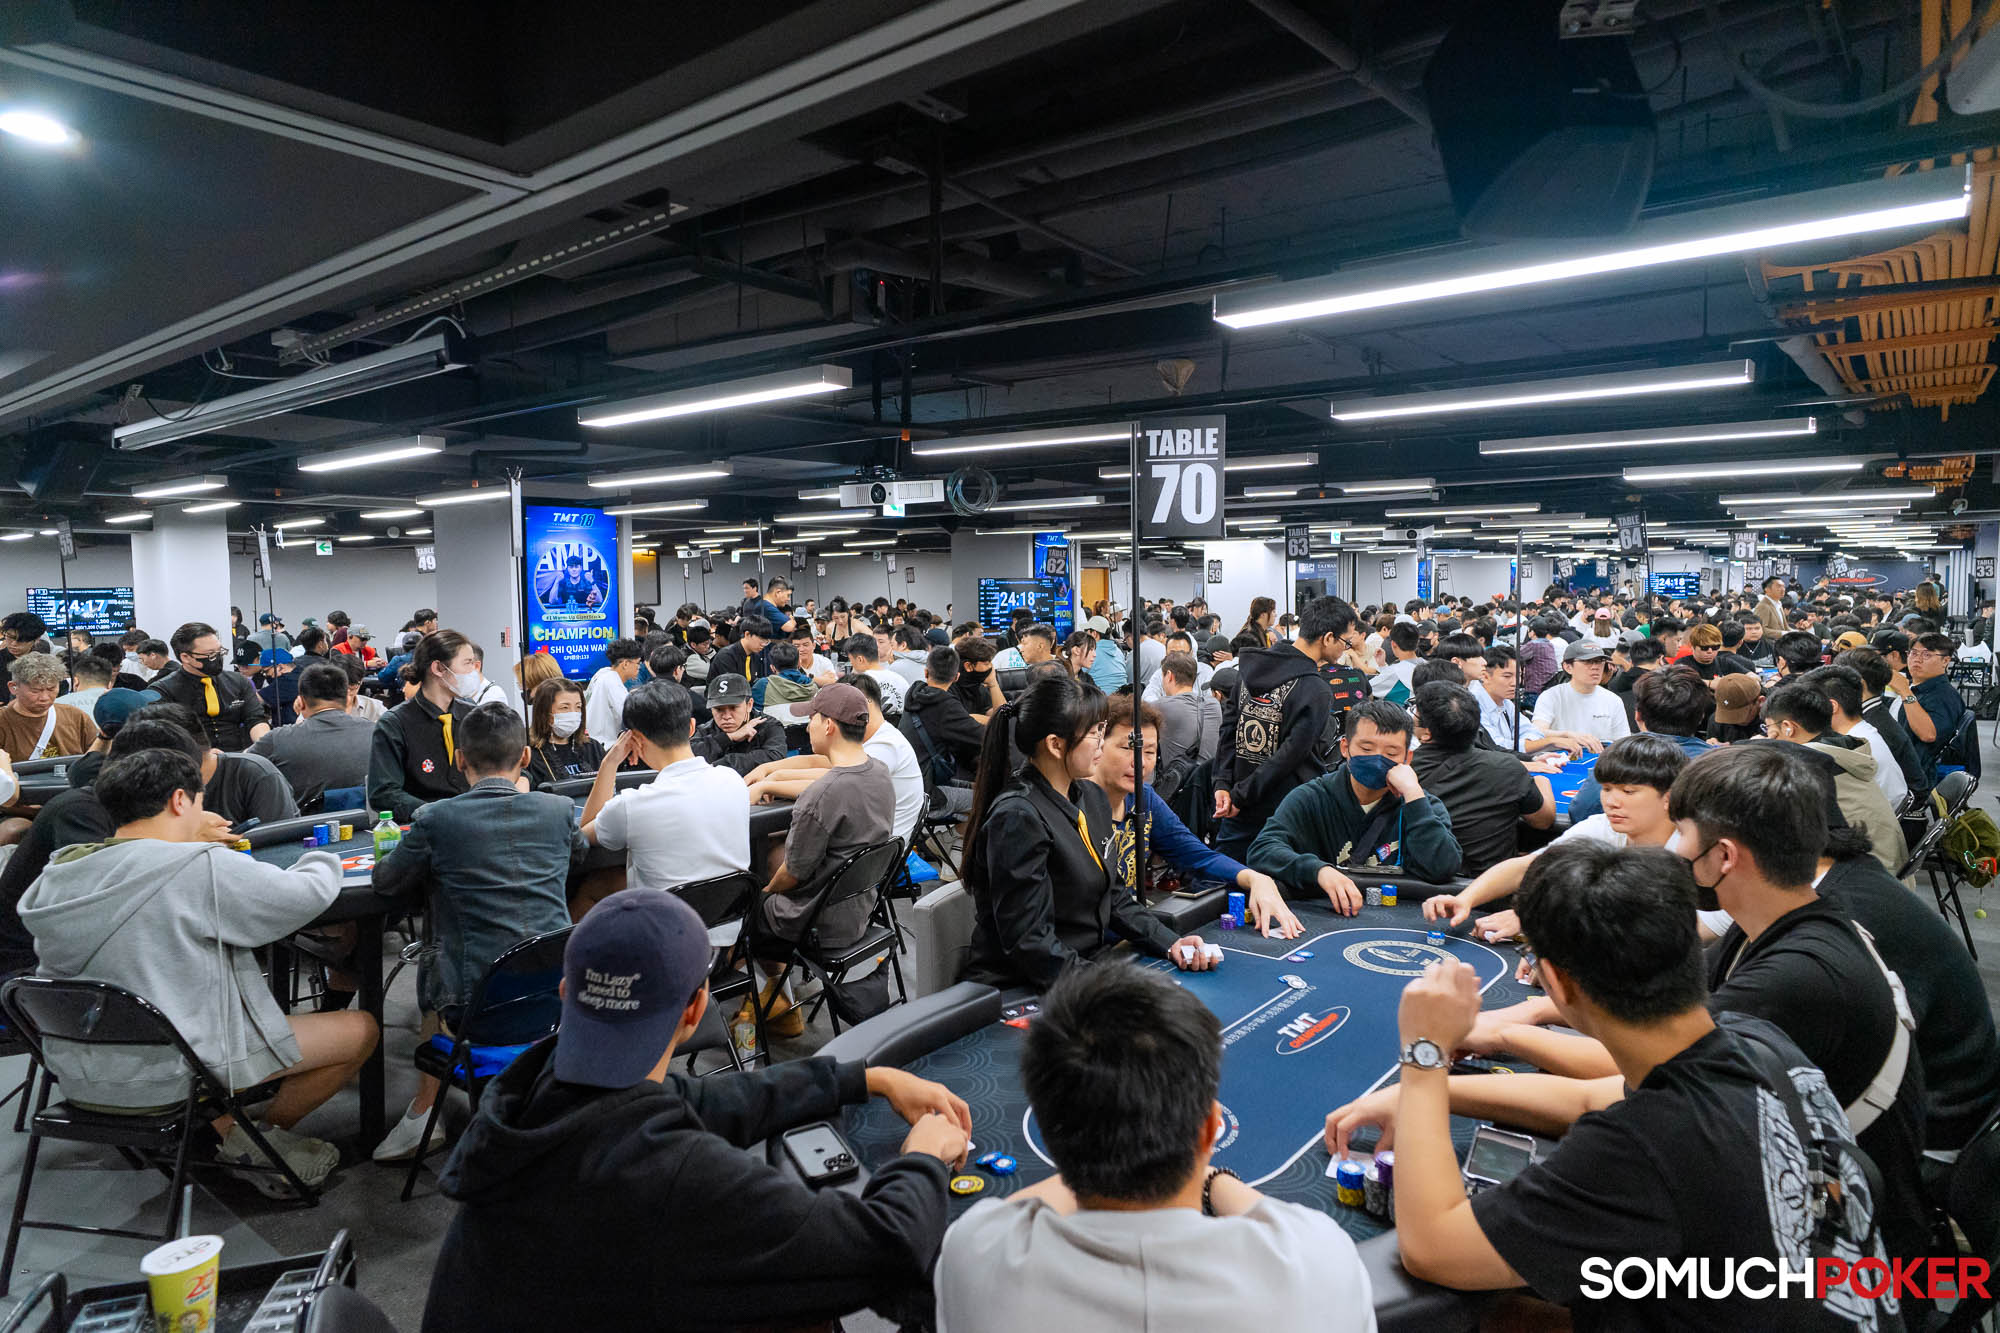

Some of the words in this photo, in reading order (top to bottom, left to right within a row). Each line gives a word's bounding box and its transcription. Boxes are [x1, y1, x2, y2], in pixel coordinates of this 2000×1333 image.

[1145, 427, 1219, 456] TABLE
[1151, 462, 1217, 524] 70
[553, 512, 579, 522] TMT
[580, 513, 595, 527] 18
[1618, 515, 1641, 527] TABLE
[1288, 528, 1308, 537] TABLE
[1620, 528, 1643, 549] 64
[1735, 532, 1756, 541] TABLE
[1288, 538, 1309, 557] 63
[418, 555, 436, 571] 49
[1046, 558, 1066, 575] 62
[1209, 569, 1222, 582] 59
[1746, 566, 1764, 579] 58
[1976, 566, 1994, 577] 33
[57, 599, 105, 613] 24:17
[1000, 591, 1035, 607] 24:18
[534, 626, 614, 641] CHAMPION
[550, 645, 565, 654] SHI
[566, 644, 590, 654] QUAN
[590, 643, 608, 652] WAN
[718, 680, 729, 693] S
[585, 968, 602, 983] I'm
[587, 984, 615, 997] need
[616, 987, 632, 999] to
[605, 999, 641, 1011] more
[1277, 1012, 1320, 1038] TMT
